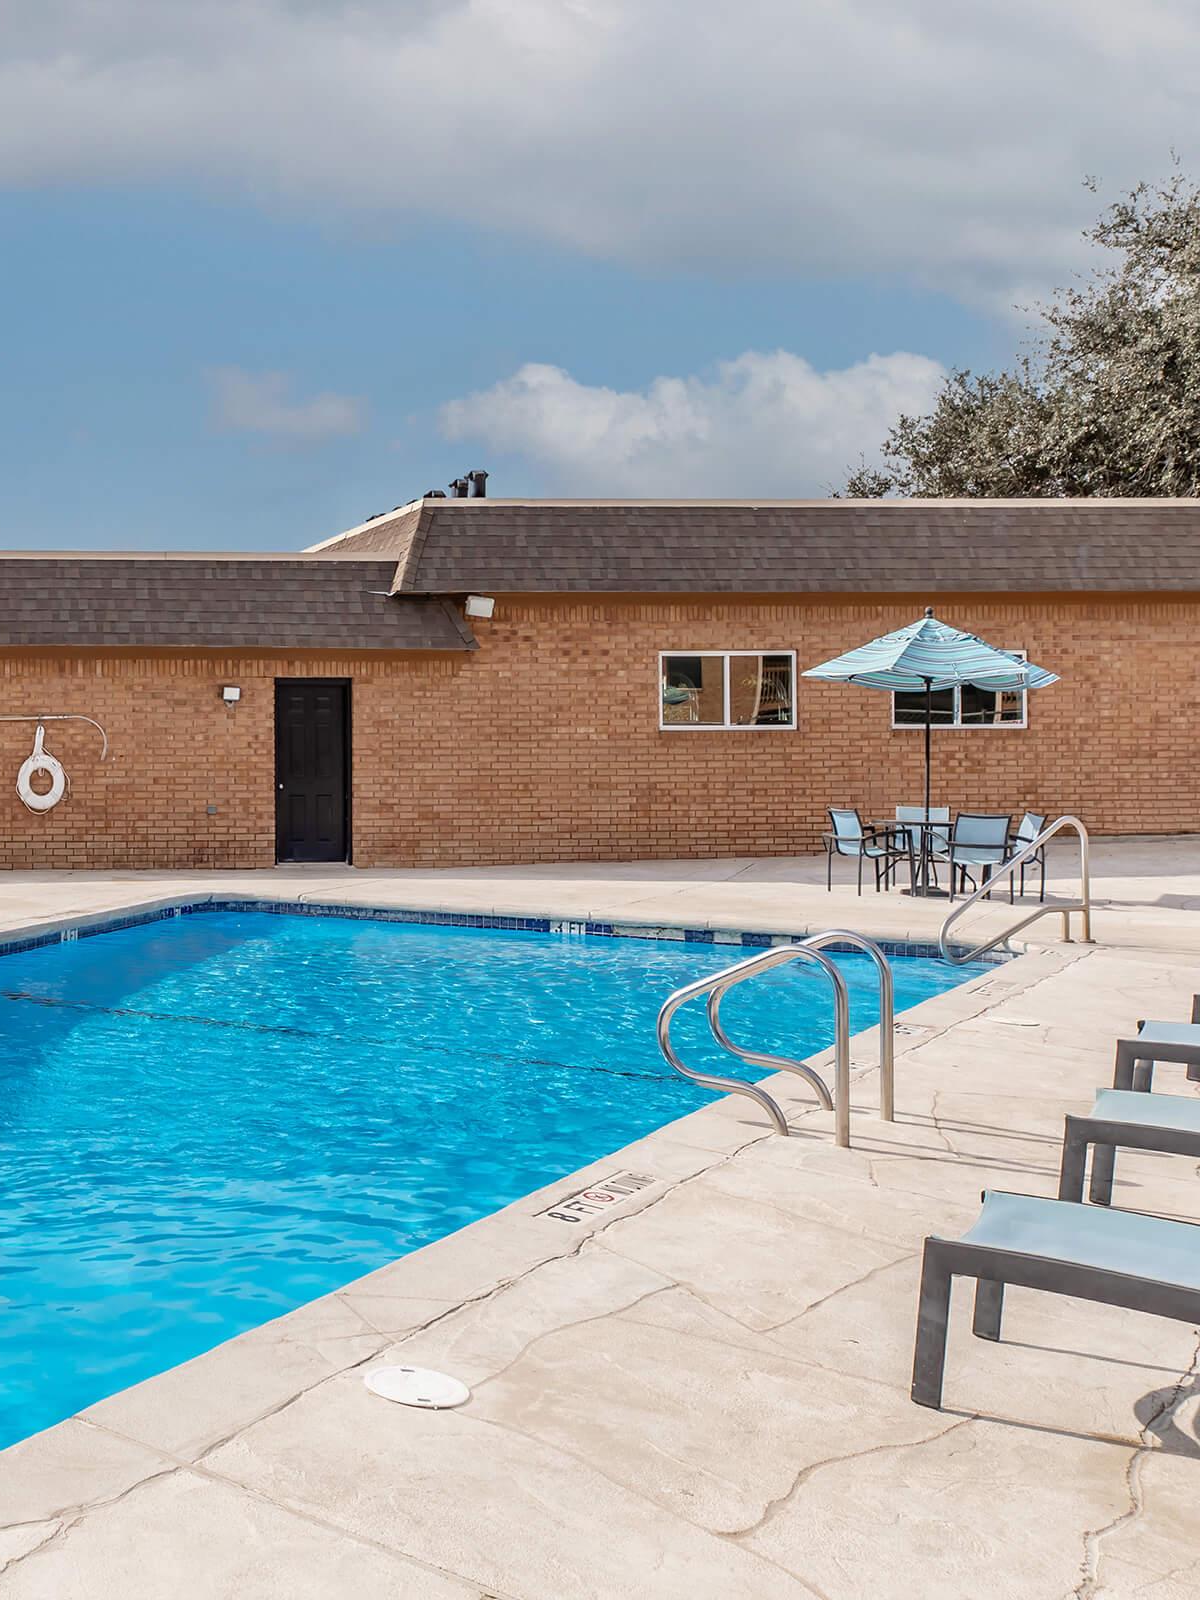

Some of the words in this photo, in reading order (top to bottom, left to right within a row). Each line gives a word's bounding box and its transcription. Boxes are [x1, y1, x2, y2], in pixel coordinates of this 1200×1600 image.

[569, 922, 584, 934] FT
[563, 1200, 604, 1215] FT
[547, 1211, 581, 1223] 8
